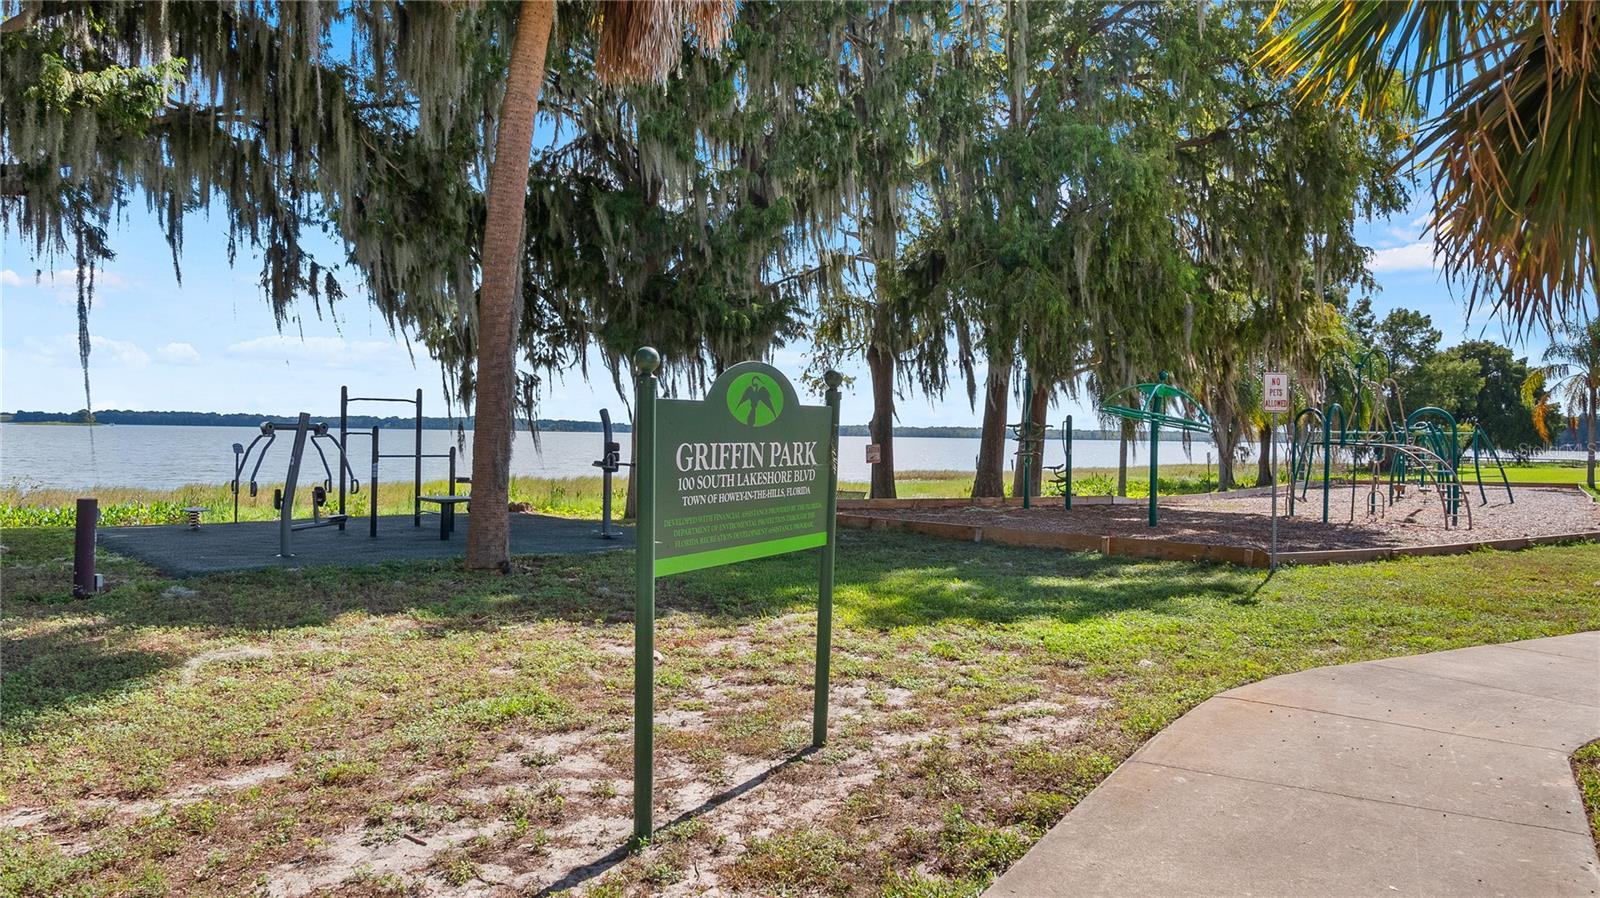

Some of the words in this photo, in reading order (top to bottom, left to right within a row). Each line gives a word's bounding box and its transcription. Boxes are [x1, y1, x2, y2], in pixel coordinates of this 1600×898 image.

[1272, 378, 1280, 386] NO
[1270, 388, 1282, 396] PETS
[676, 442, 765, 472] GRIFFIN
[769, 441, 818, 467] PARK
[678, 477, 694, 491] 100
[697, 474, 735, 490] SOUTH
[737, 470, 793, 486] LAKESHORE
[794, 469, 816, 482] BLVD
[682, 494, 706, 506] TOWN
[708, 494, 717, 504] OF
[786, 486, 811, 496] FLORIDA
[664, 517, 696, 528] DEVELOPED
[713, 511, 740, 521] FINANCIAL
